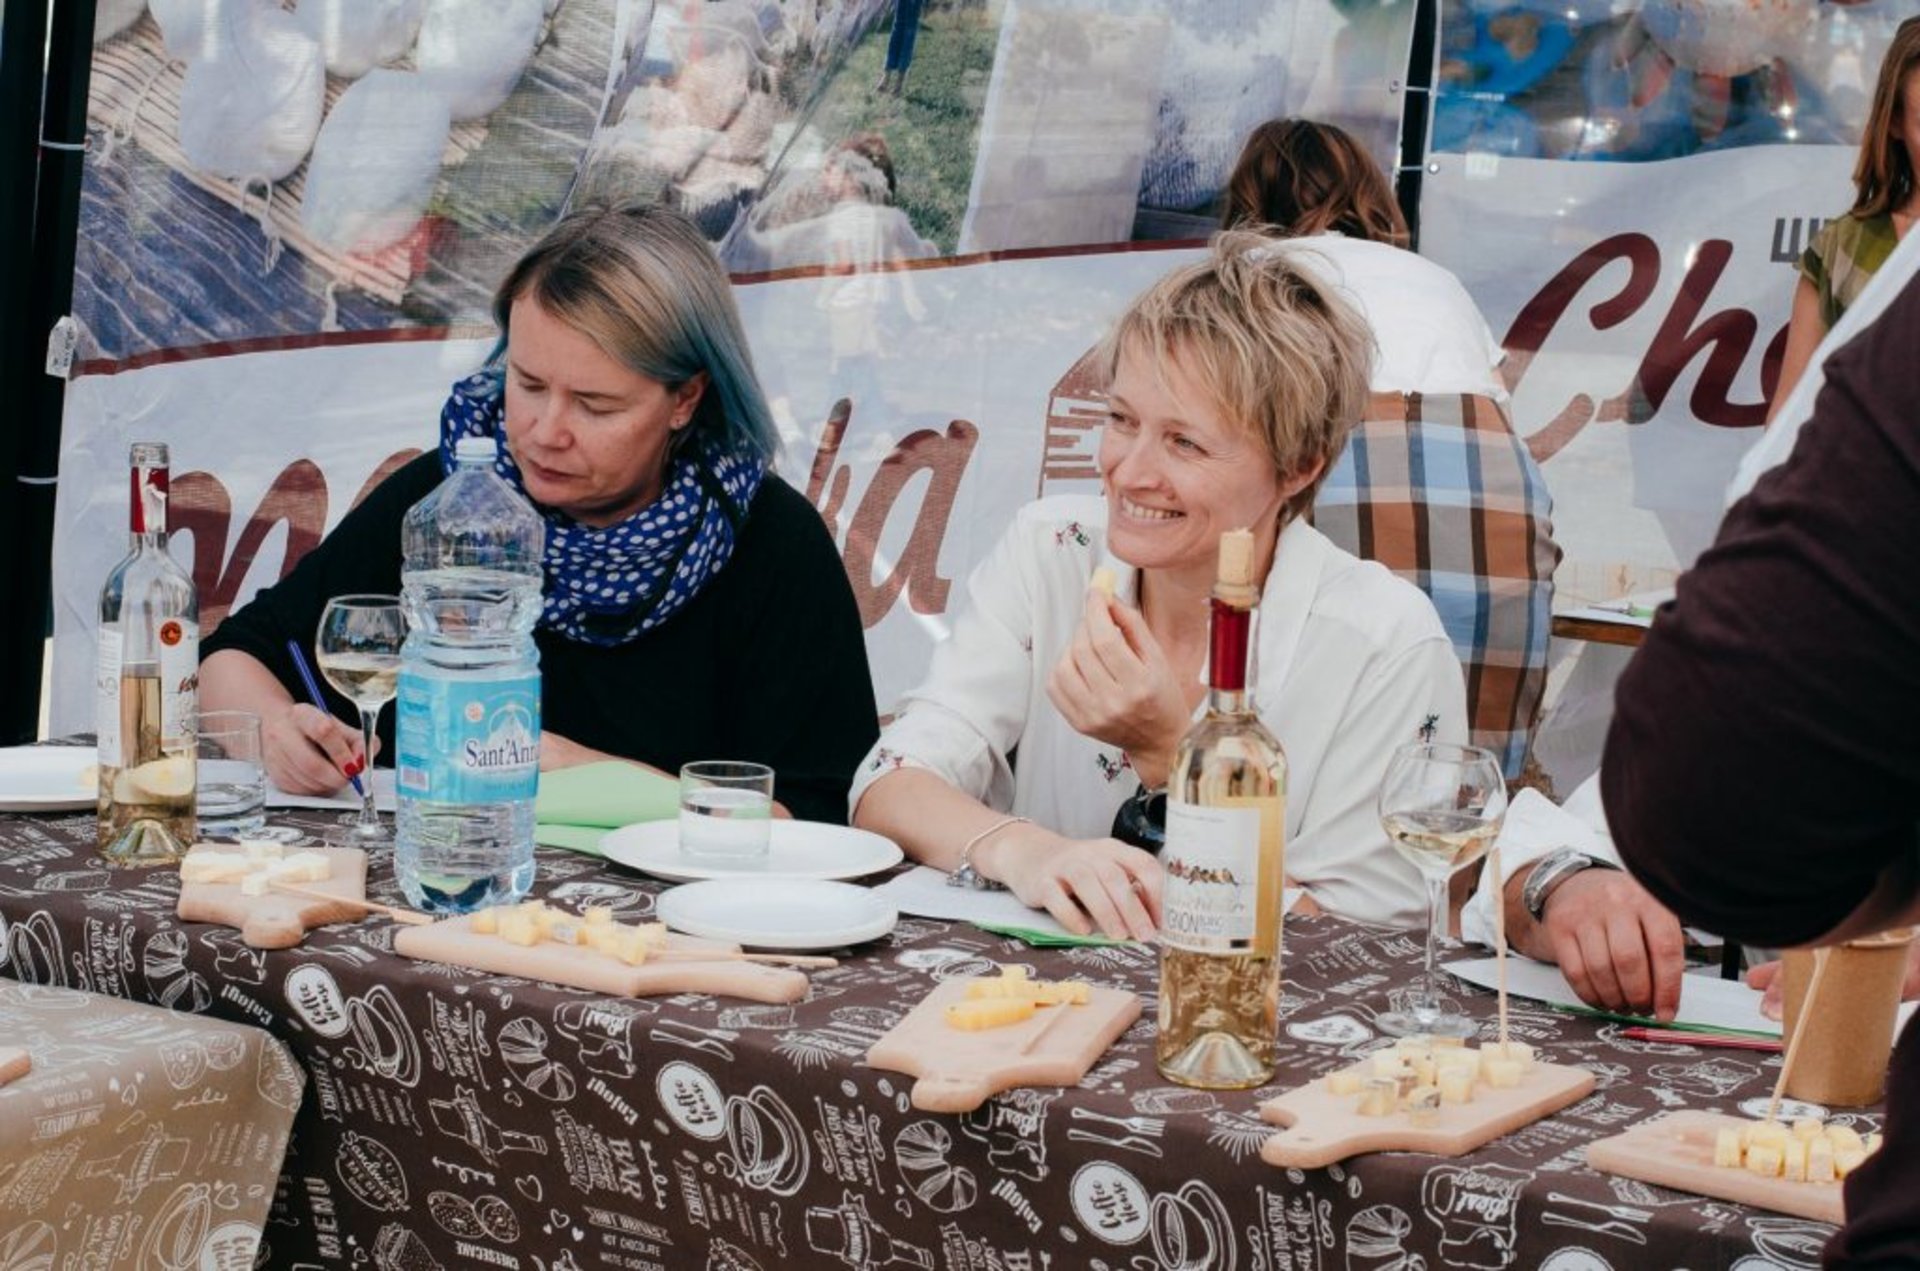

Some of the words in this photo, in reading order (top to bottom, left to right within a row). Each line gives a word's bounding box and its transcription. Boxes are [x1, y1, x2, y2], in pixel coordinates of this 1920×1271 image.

[220, 983, 274, 1027] Enjoy!
[299, 982, 329, 1026] Coffee
[586, 1076, 639, 1126] Enjoy!
[674, 1080, 705, 1125] Coffee
[607, 1136, 645, 1203] BAR
[303, 1176, 342, 1260] MENU
[990, 1178, 1043, 1234] Enjoy!
[1089, 1180, 1122, 1229] Coffee
[1112, 1181, 1141, 1223] House
[1266, 1191, 1287, 1225] START
[1285, 1196, 1314, 1244] Coffee
[455, 1240, 521, 1271] CHEESECAKE
